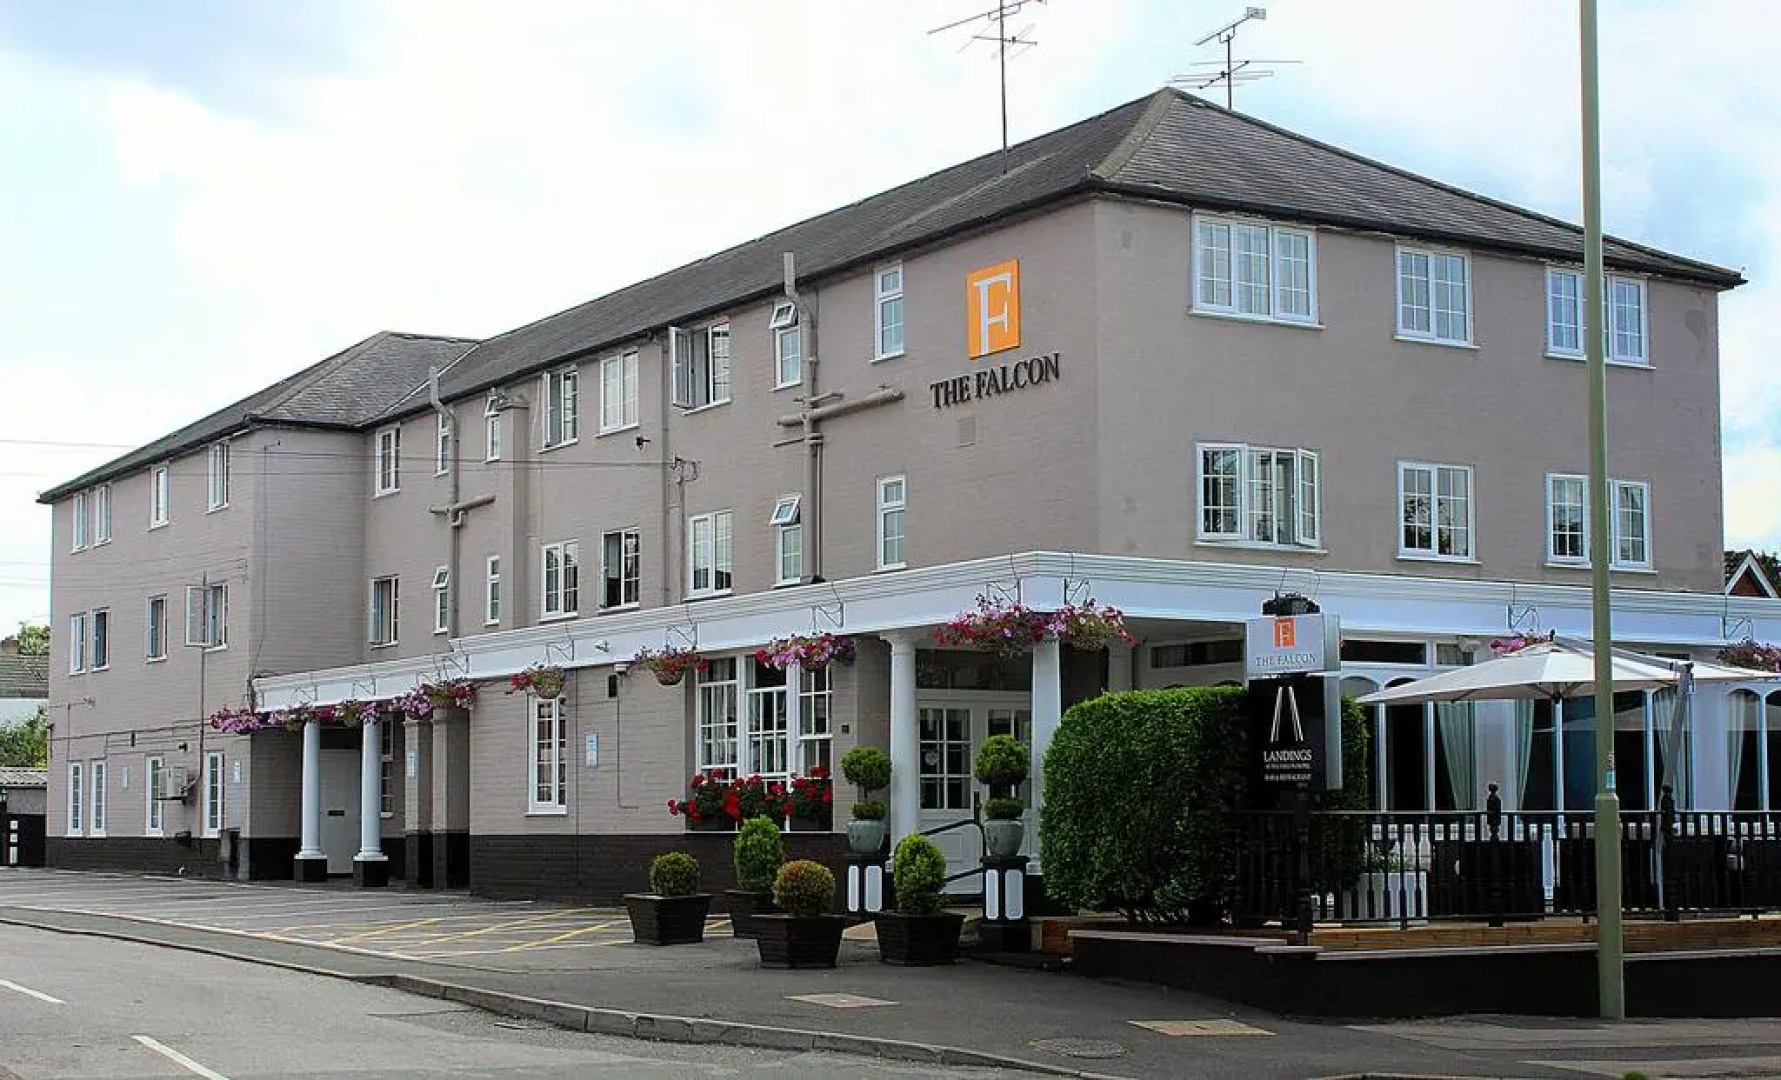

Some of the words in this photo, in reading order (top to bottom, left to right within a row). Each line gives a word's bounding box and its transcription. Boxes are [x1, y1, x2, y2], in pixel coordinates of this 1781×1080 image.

[973, 272, 1011, 356] F
[930, 375, 971, 409] THE
[975, 352, 1060, 399] FALCON
[1278, 622, 1292, 647] F
[1256, 656, 1275, 667] THE
[1277, 653, 1316, 665] FALCON
[1263, 749, 1312, 763] LANDINGS
